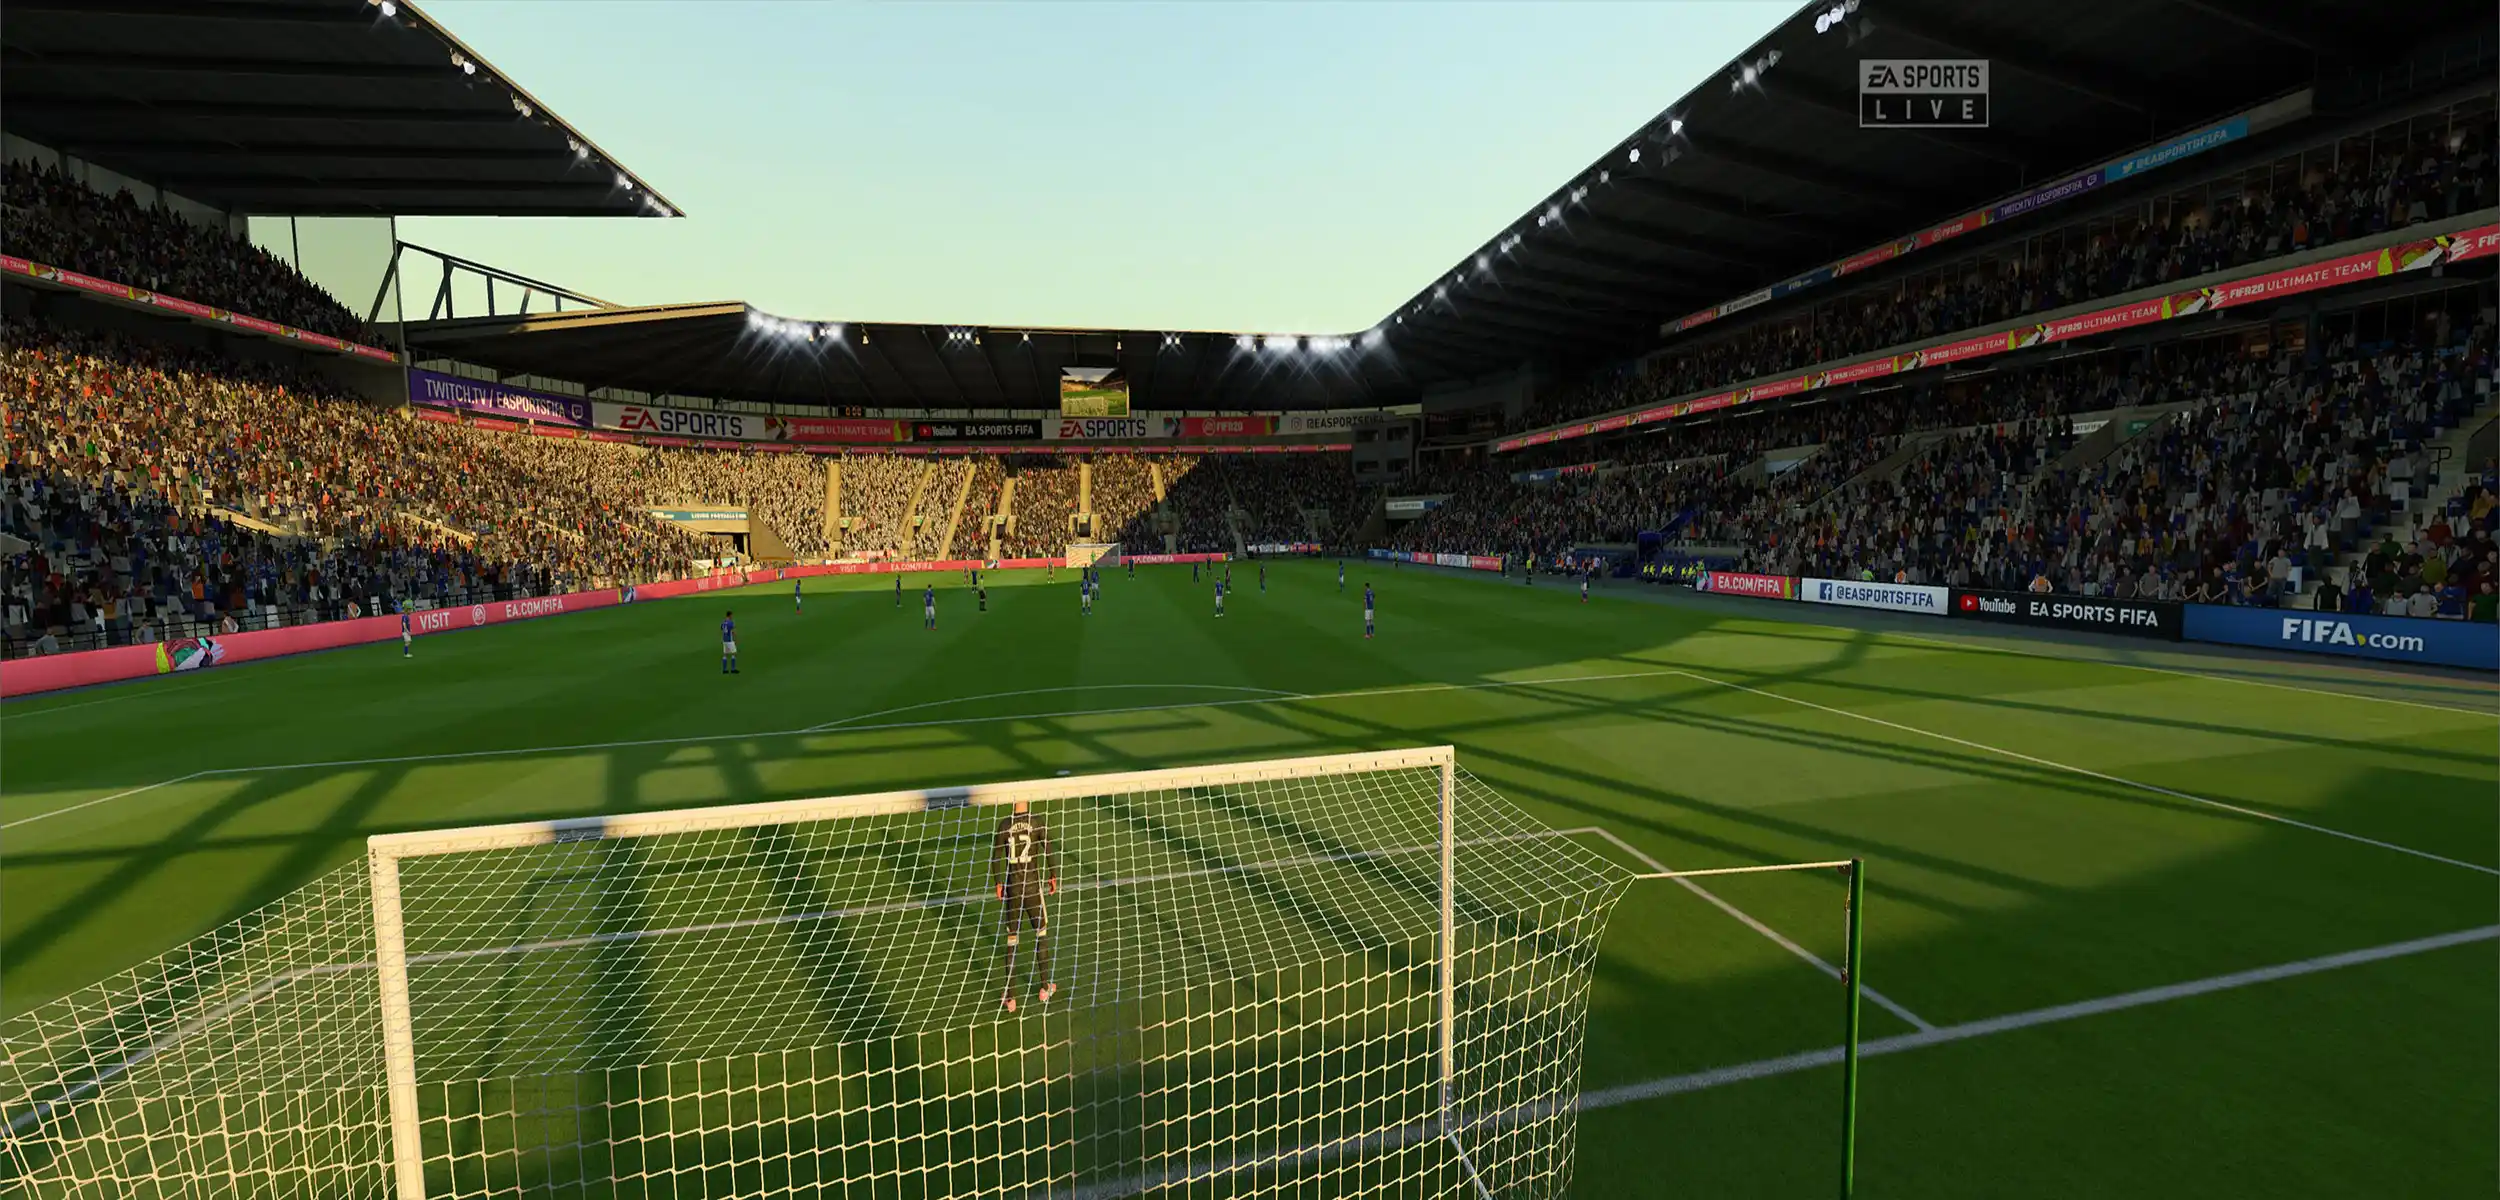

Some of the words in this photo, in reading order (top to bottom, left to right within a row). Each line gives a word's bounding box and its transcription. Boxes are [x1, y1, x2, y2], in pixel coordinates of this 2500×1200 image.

[2267, 269, 2329, 293] ULTIMATE
[2335, 260, 2372, 277] TEAM
[2084, 312, 2127, 329] ULTIMATE
[2131, 305, 2158, 319] TEAM
[425, 378, 487, 408] TWITCH.TV
[496, 391, 566, 418] EASPORTSFIFA
[619, 407, 660, 431] EA
[660, 410, 743, 437] SPORTS
[825, 425, 867, 436] ULTIMATE
[868, 426, 891, 436] TEAM
[932, 425, 958, 437] YouTube
[965, 425, 977, 436] EA
[979, 425, 1013, 436] SPORTS
[1015, 425, 1034, 436] FIFA
[1059, 420, 1085, 437] EA
[1086, 420, 1146, 438] SPORTS
[1718, 575, 1780, 594] EA.COM/FIFA
[1836, 586, 1934, 607] @EASPORTSFIFA
[419, 612, 450, 630] VISIT
[505, 598, 564, 618] EA.COM/FIFA
[1979, 596, 2016, 614] YouTube
[2030, 602, 2049, 617] EA
[2052, 603, 2116, 623] SPORTS
[2119, 608, 2159, 627] FIFA
[1008, 834, 1033, 864] 12
